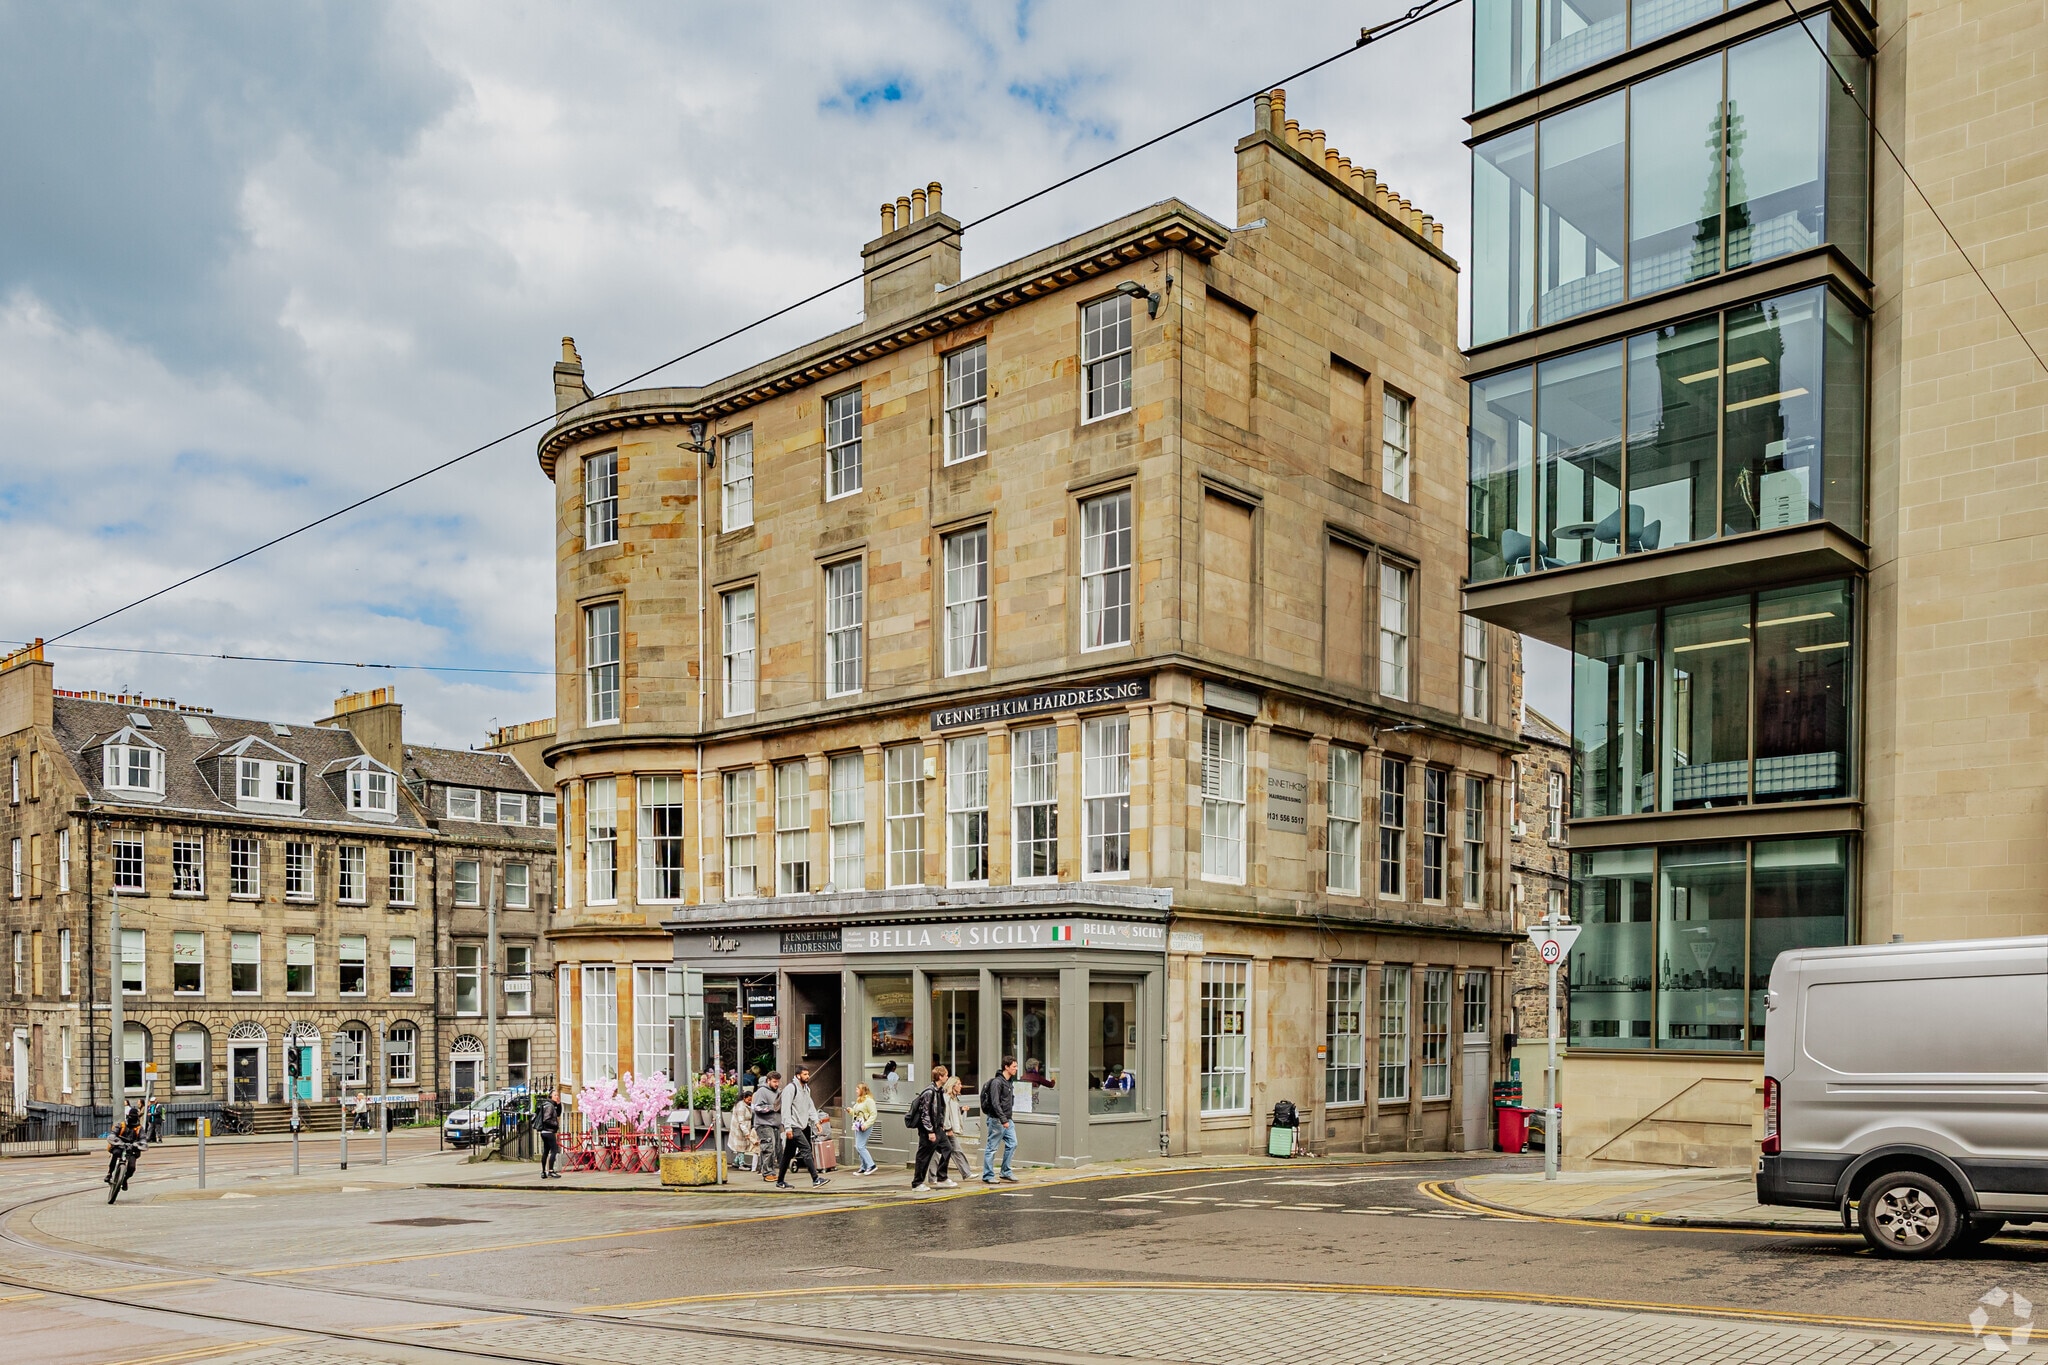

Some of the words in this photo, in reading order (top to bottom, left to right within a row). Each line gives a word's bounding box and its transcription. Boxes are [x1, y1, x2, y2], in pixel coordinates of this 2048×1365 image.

[1267, 777, 1306, 792] ENNETHKIM
[1269, 793, 1301, 803] HAIRDRESSING
[1280, 814, 1291, 823] 556
[1291, 815, 1305, 825] 5517
[869, 929, 932, 948] BELLA
[969, 925, 1041, 945] SICILY
[1083, 923, 1116, 935] BELLA
[1132, 926, 1164, 939] SICILY
[710, 935, 719, 951] The
[719, 935, 737, 953] Square
[782, 941, 842, 953] HAIRDRESSING
[1544, 946, 1557, 957] 20
